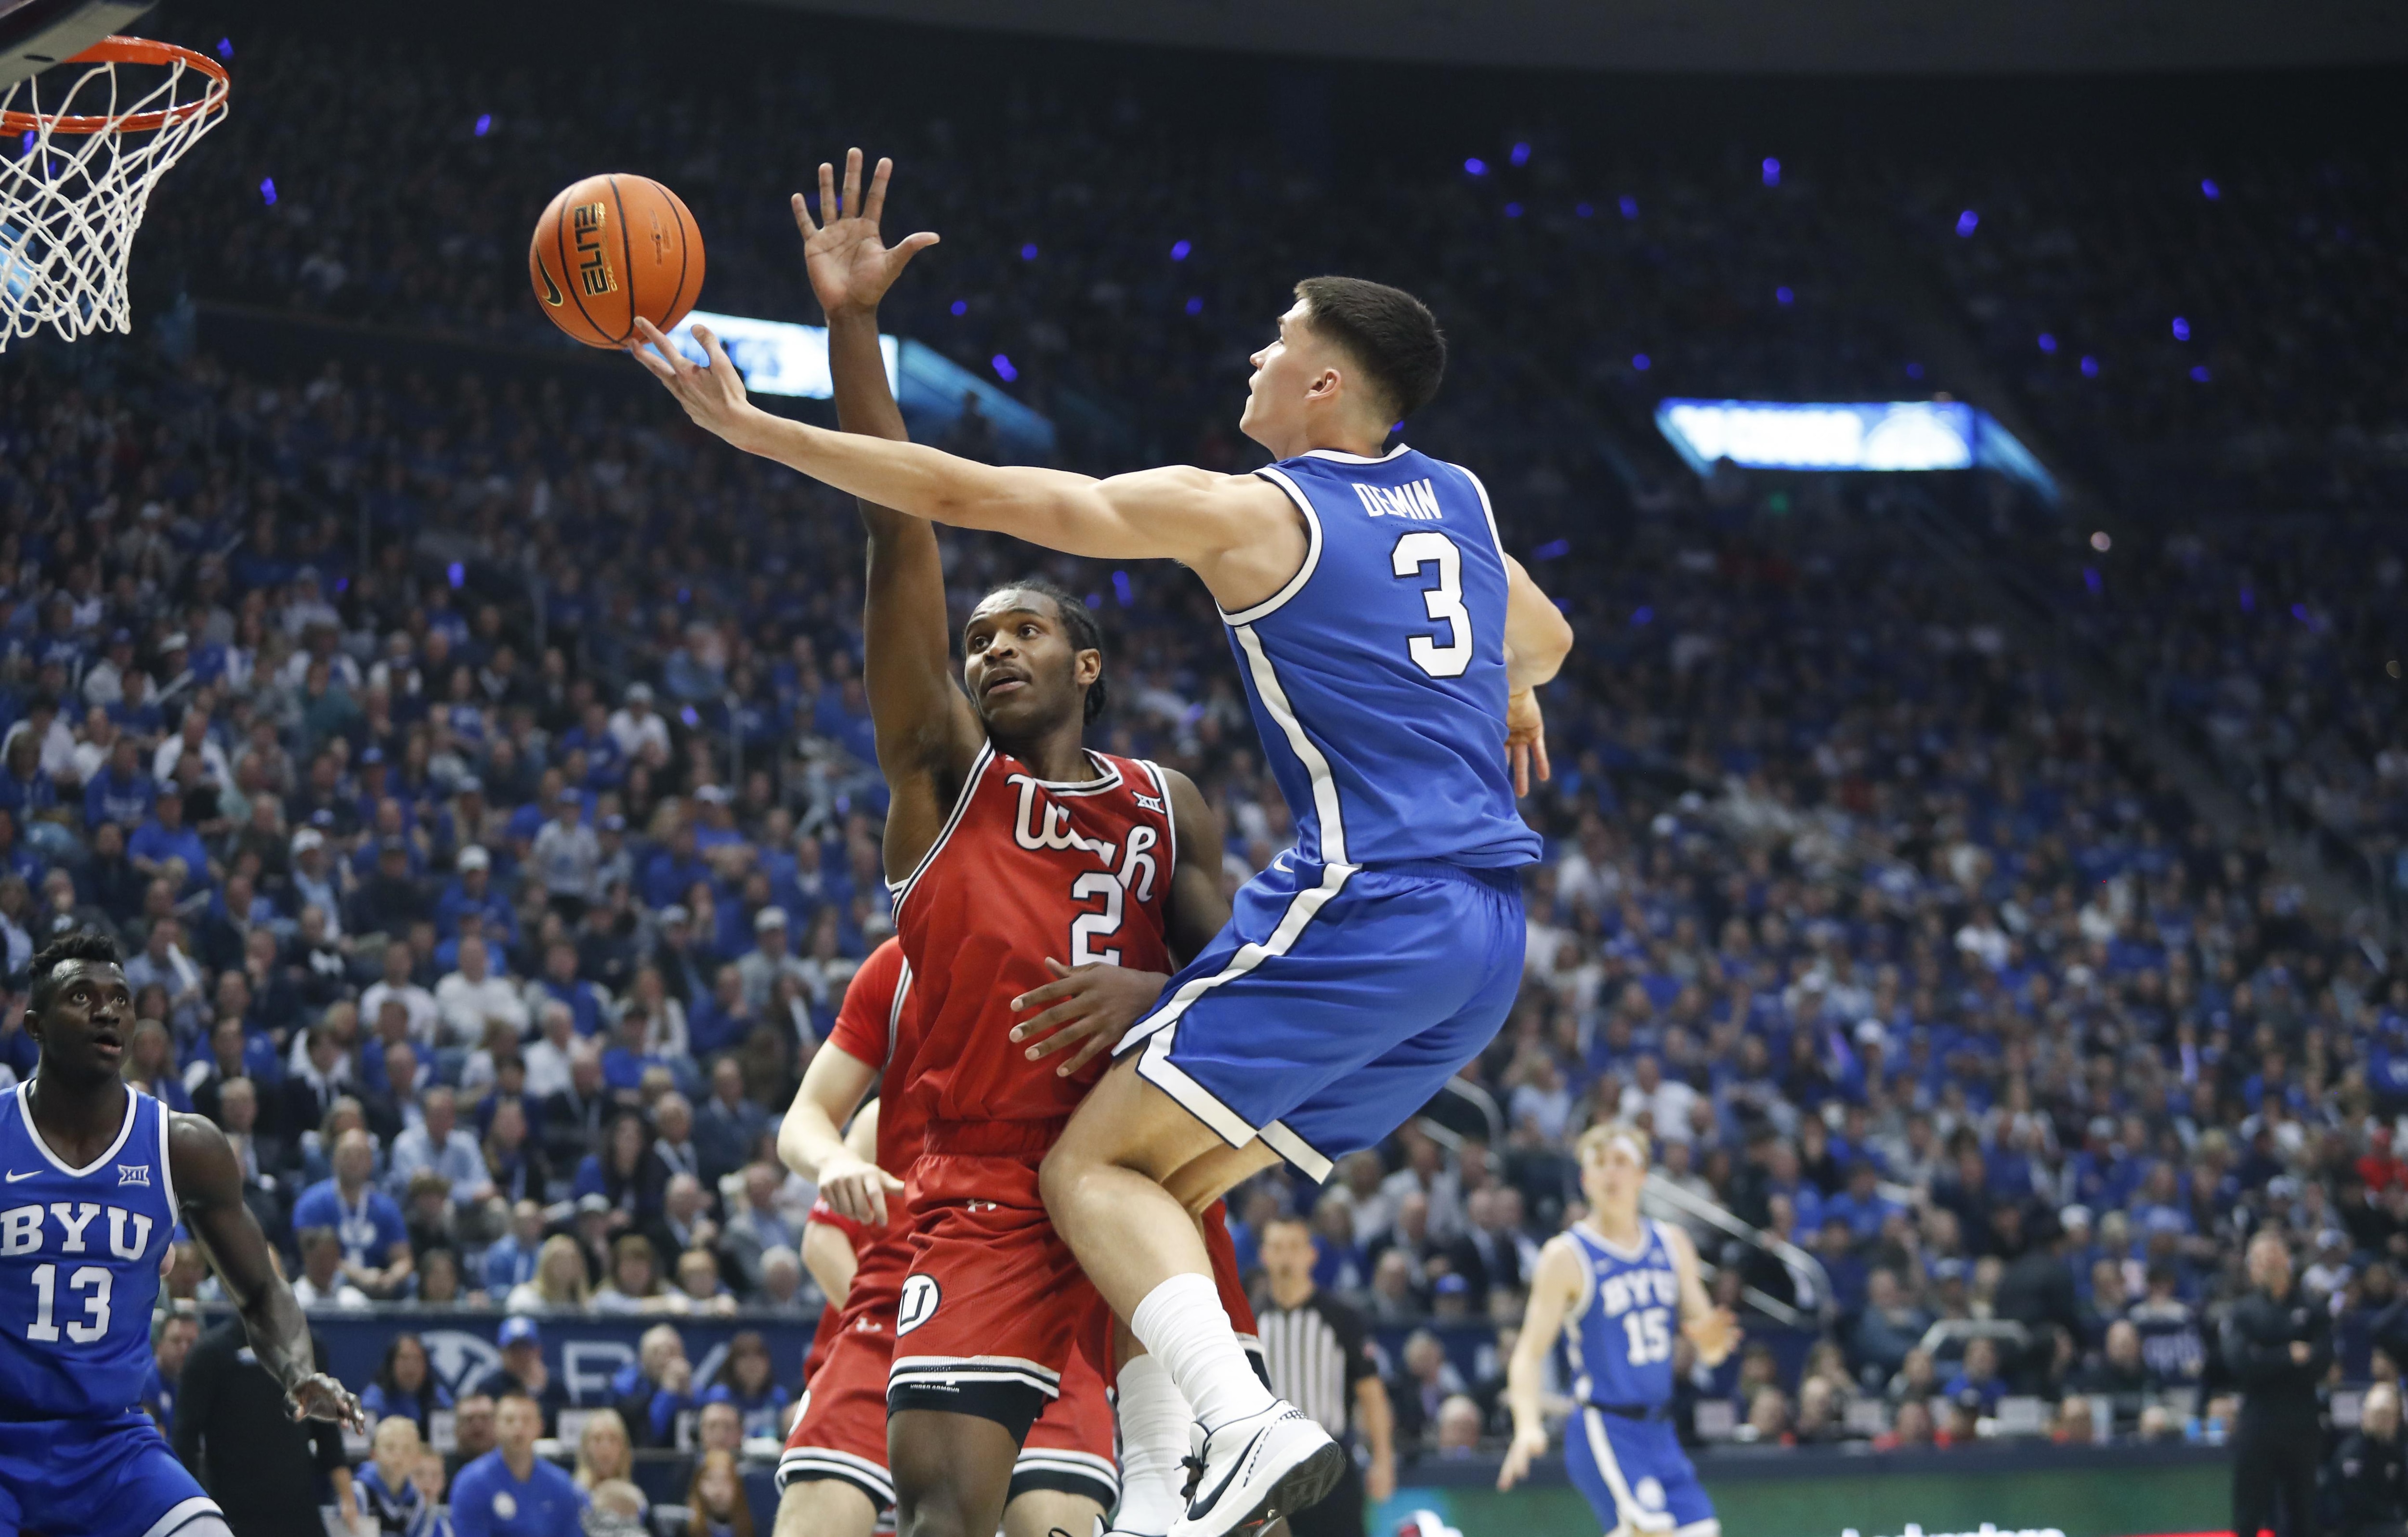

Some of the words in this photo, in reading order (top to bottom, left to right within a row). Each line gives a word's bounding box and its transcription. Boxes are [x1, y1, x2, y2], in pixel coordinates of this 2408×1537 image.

[574, 202, 610, 296] ELITE
[1351, 478, 1442, 520] DEMIN
[1390, 530, 1473, 680] 3
[1071, 870, 1125, 966] 2
[118, 1164, 149, 1185] XII
[0, 1202, 153, 1262] BYU
[26, 1263, 114, 1344] 13
[1622, 1306, 1671, 1368] 15
[931, 1384, 960, 1394] ARMOUR
